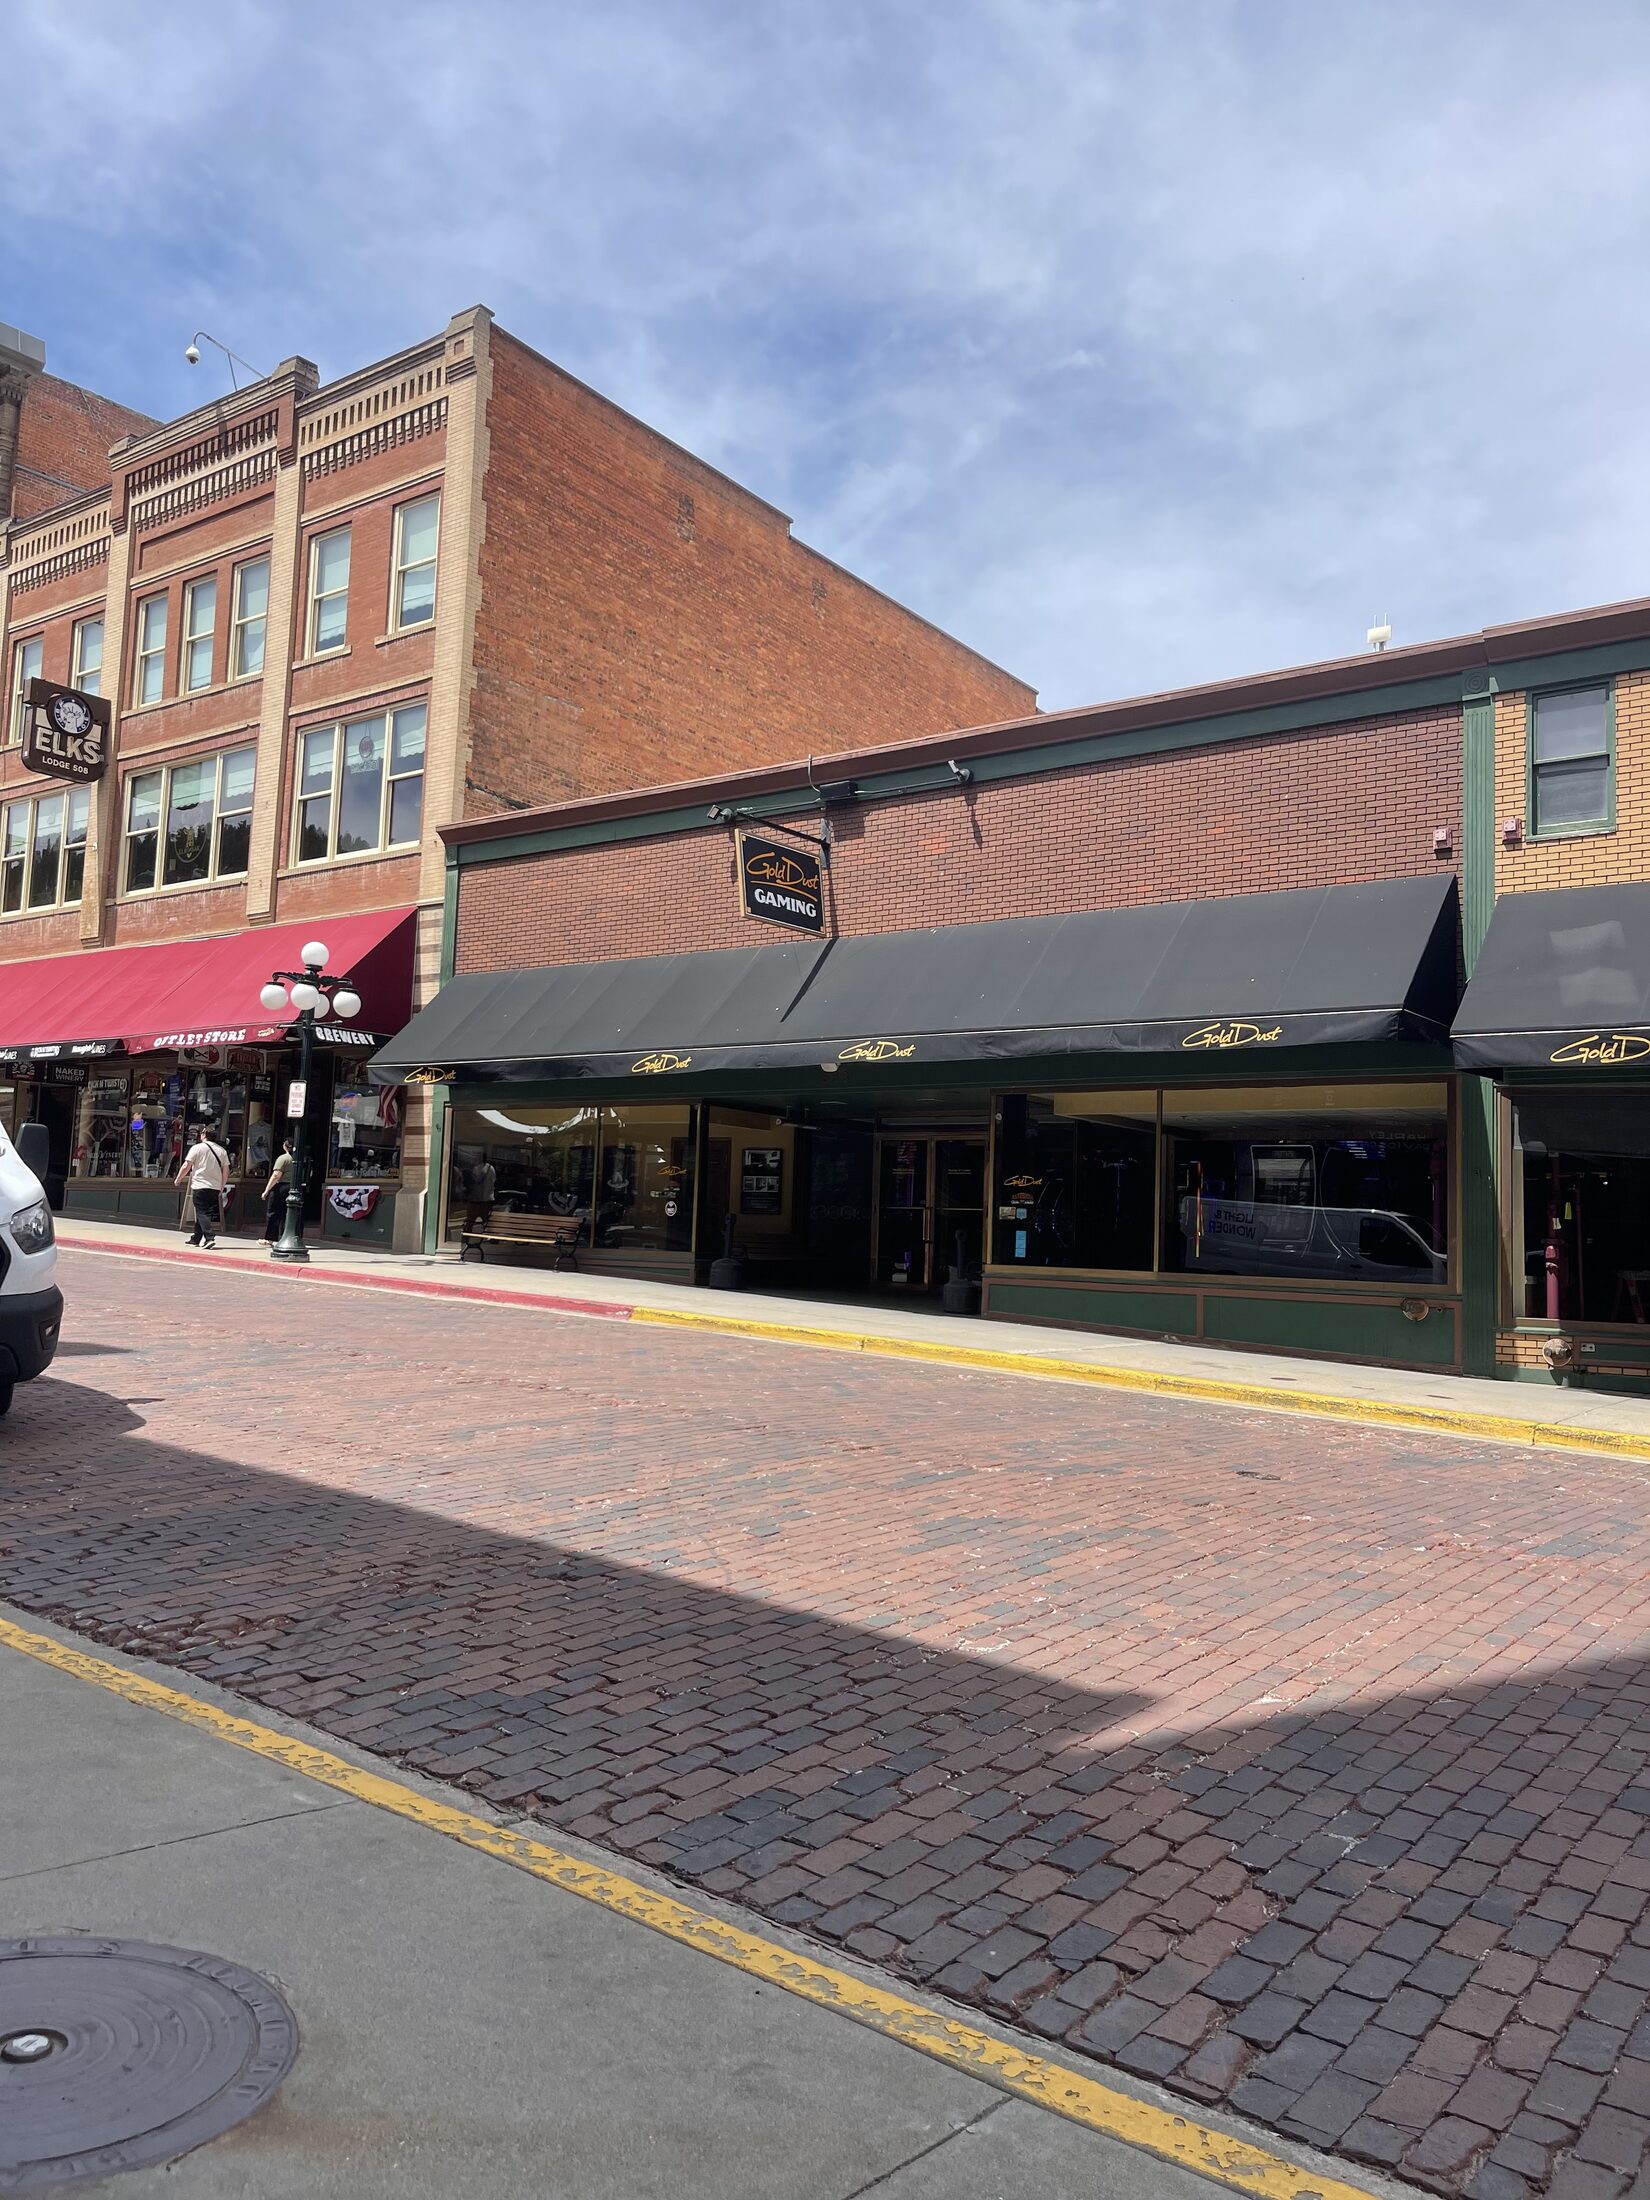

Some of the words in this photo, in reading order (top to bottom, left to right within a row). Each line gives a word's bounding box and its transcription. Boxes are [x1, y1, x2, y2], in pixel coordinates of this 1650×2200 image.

[35, 726, 101, 764] ELKS
[42, 756, 70, 770] LODGE
[72, 764, 89, 774] 508
[746, 852, 785, 880] Gold
[776, 857, 820, 889] Dust
[754, 888, 817, 917] GAMING
[153, 1033, 203, 1047] OUTLET
[203, 1029, 246, 1043] STORE
[315, 1026, 375, 1045] BREWERY
[1182, 1023, 1235, 1047] Gold
[1220, 1023, 1283, 1047] Dust
[838, 1041, 880, 1059] Gold
[866, 1041, 916, 1060] Dust
[1550, 1035, 1619, 1063] Gold
[55, 1067, 85, 1077] NAKED
[631, 1054, 664, 1073] Gold
[653, 1054, 692, 1072] Dust
[55, 1073, 84, 1081] WINERY
[404, 1067, 432, 1083] Gold
[424, 1067, 457, 1084] Dust
